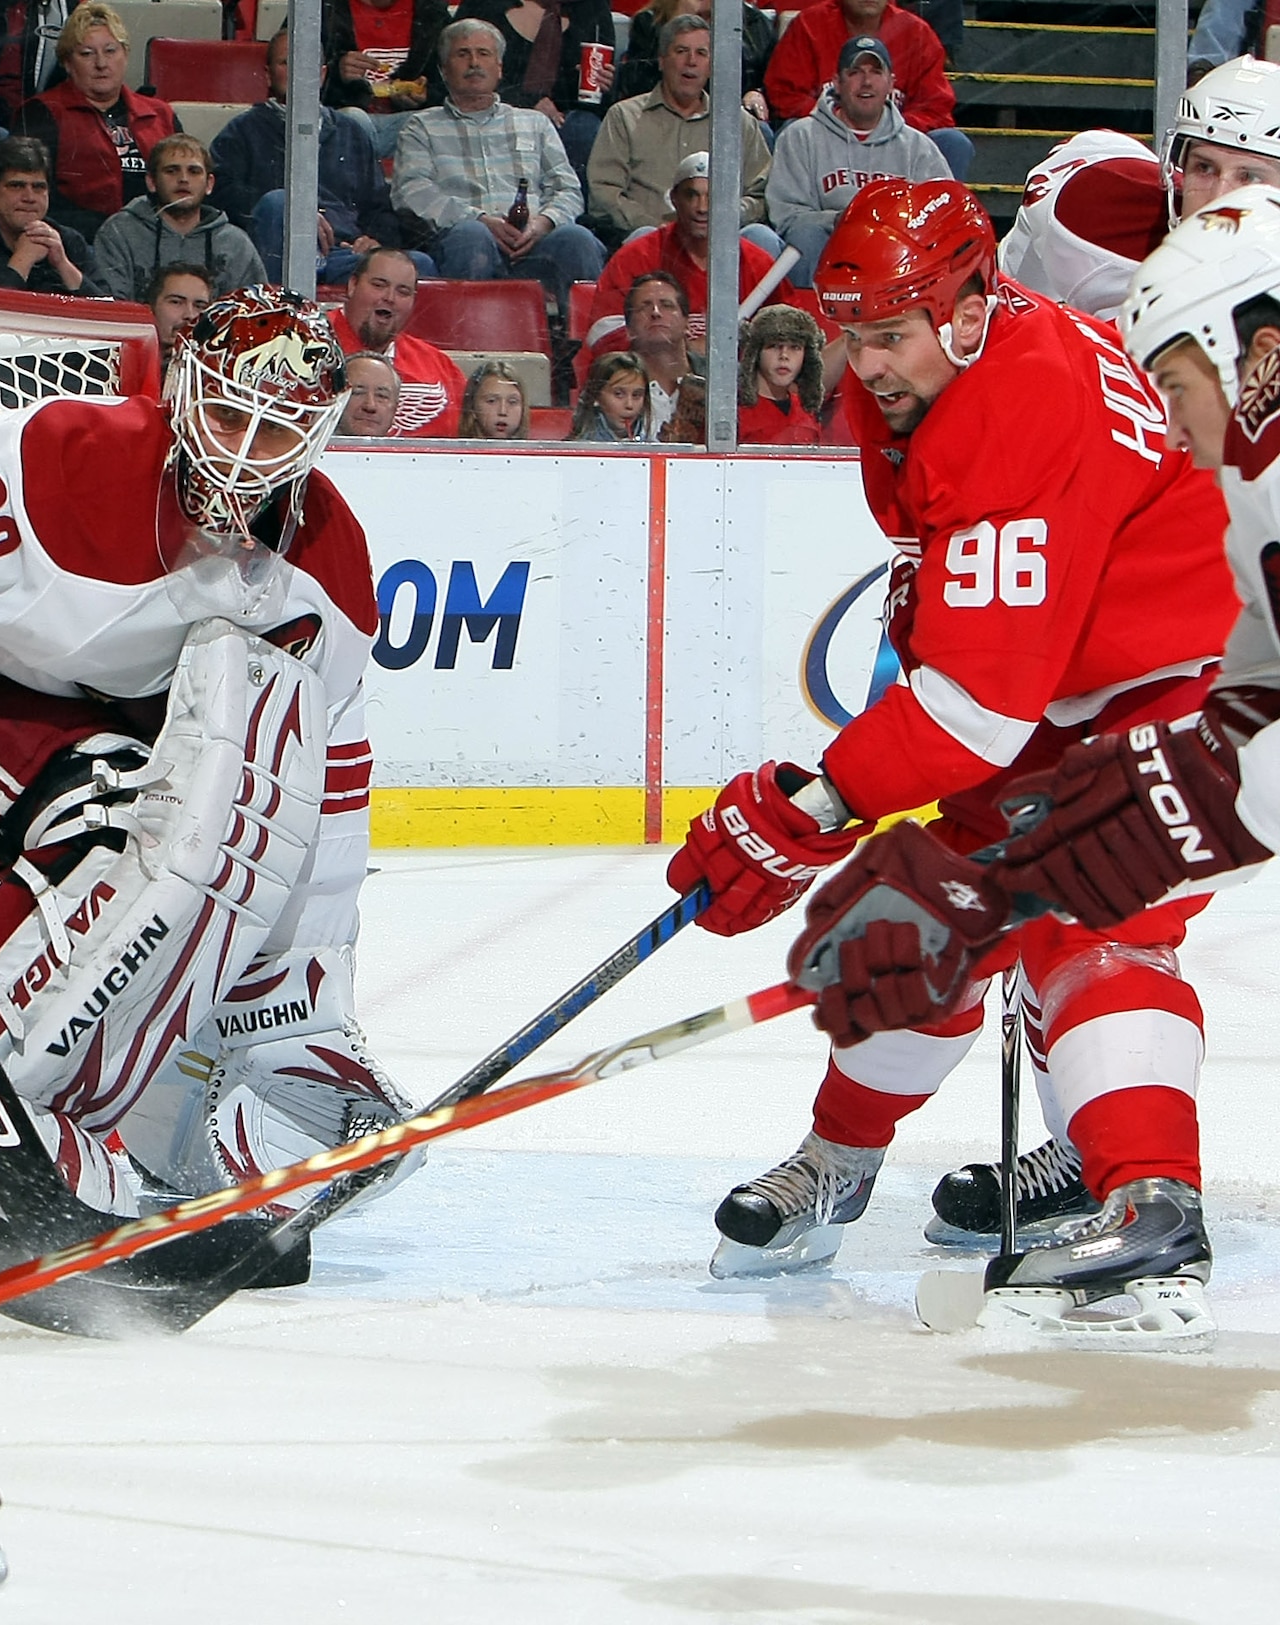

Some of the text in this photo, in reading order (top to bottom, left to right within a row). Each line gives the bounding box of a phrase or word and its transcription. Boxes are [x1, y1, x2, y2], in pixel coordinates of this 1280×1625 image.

[822, 292, 861, 301] BAUER
[943, 518, 1048, 608] 96
[371, 559, 531, 671] OM
[1129, 725, 1214, 863] STON
[46, 914, 169, 1067] VAUGHN
[215, 1000, 309, 1038] VAUGHN
